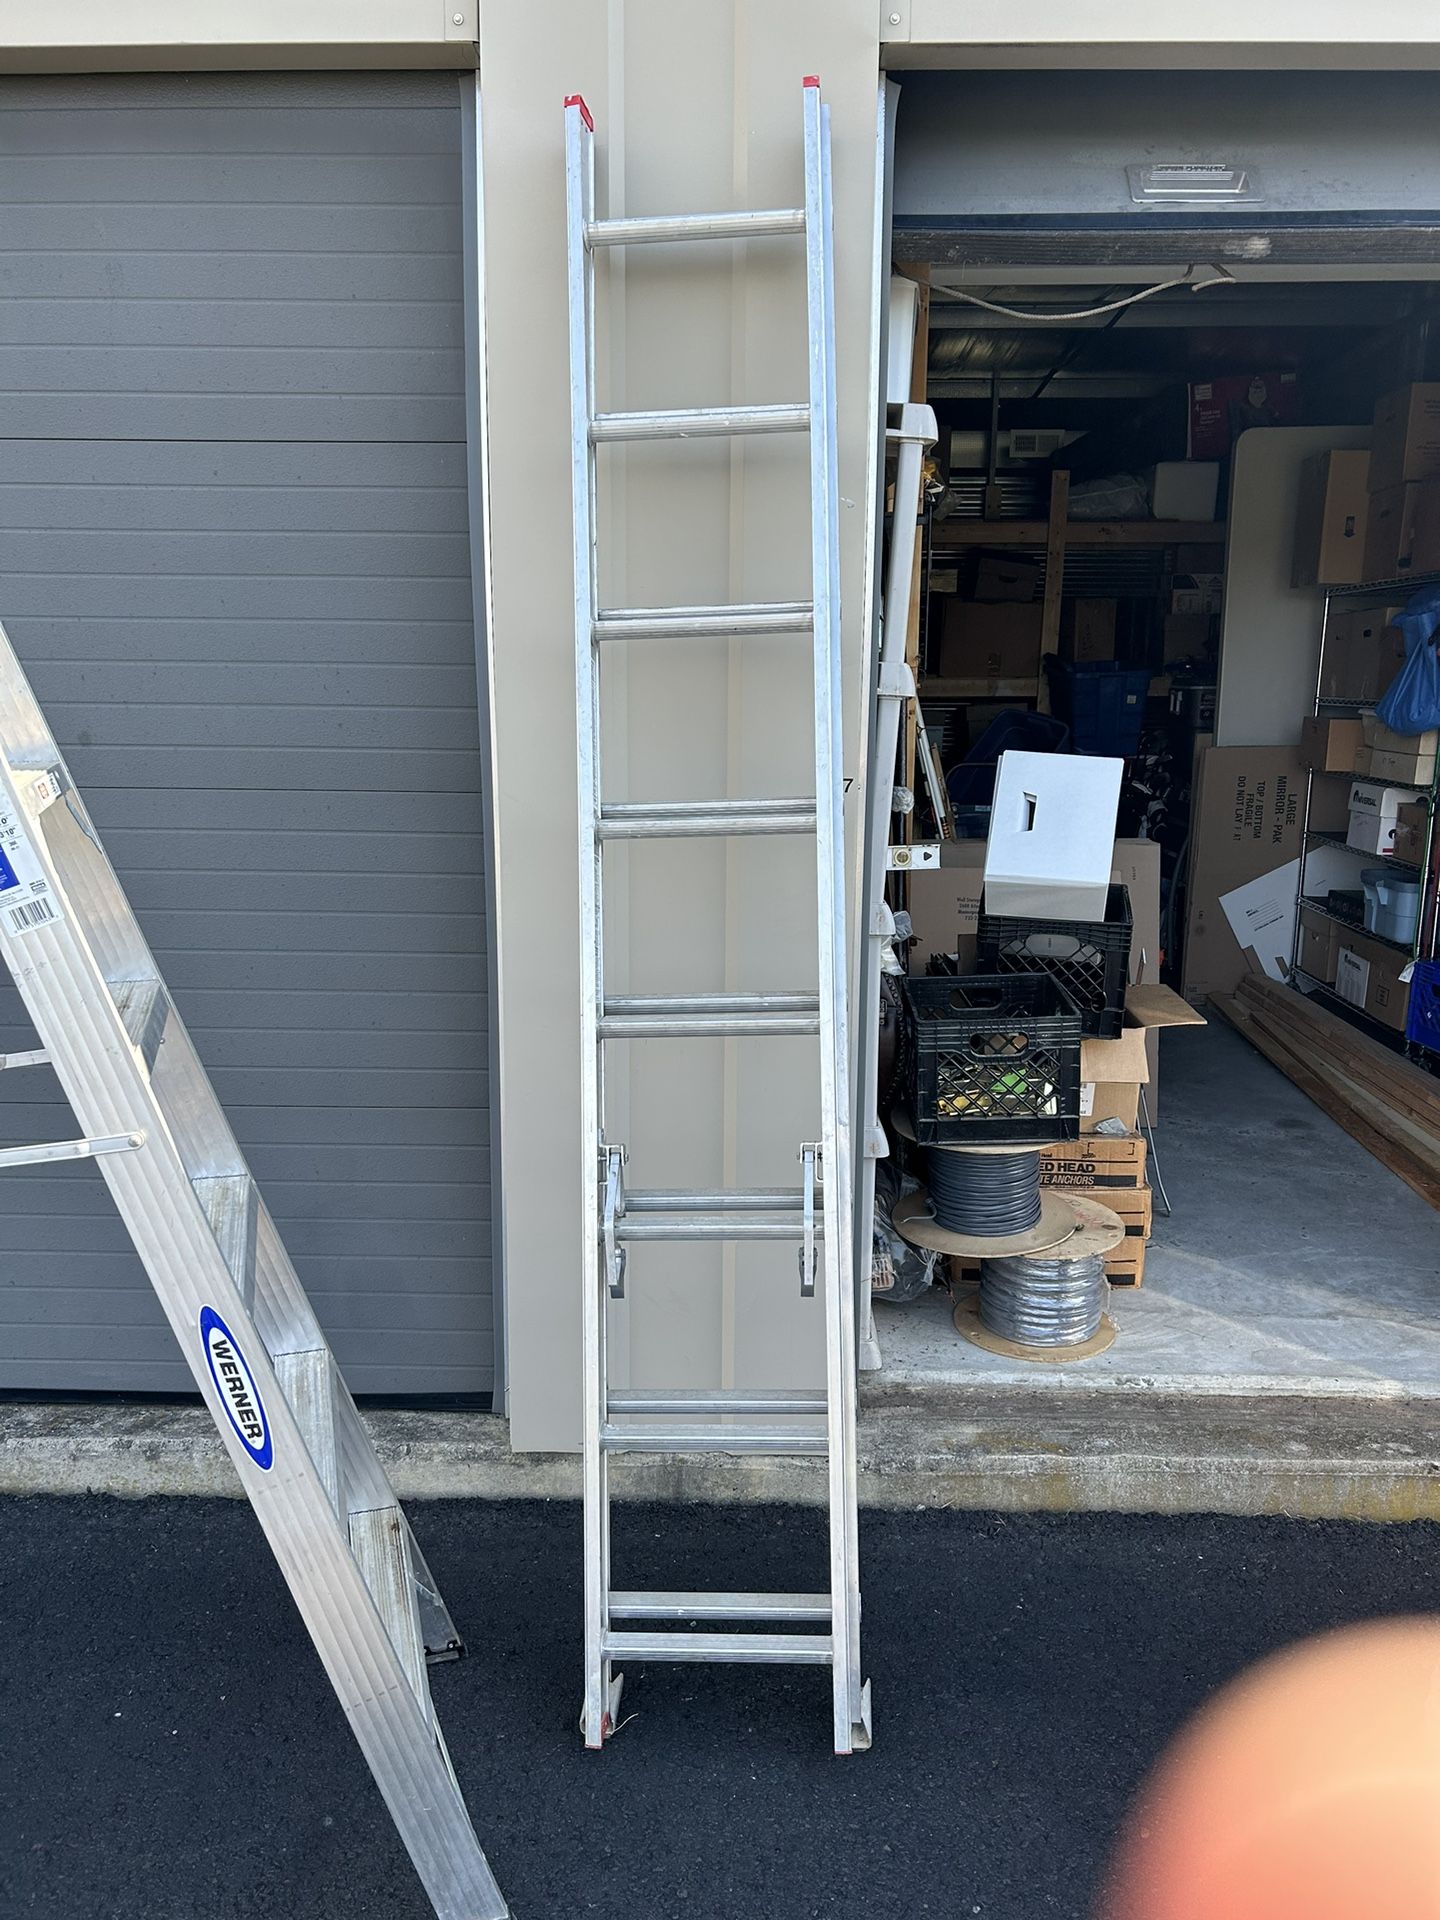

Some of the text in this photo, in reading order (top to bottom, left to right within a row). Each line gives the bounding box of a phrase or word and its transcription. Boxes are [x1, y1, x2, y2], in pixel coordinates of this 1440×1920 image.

[1237, 776, 1246, 788] DO
[1257, 781, 1266, 797] TOP
[1236, 790, 1245, 806] NOT
[1275, 776, 1287, 815] MIRROR
[1235, 808, 1244, 823] LAY
[1244, 793, 1255, 827] FRAGILE
[1286, 794, 1298, 825] LARGE
[1253, 805, 1264, 839] BOTTOM
[1272, 825, 1283, 843] PAK
[1039, 1162, 1096, 1173] ED HEAD
[1051, 1175, 1095, 1185] ANCHORS
[212, 1339, 264, 1440] WERNER
